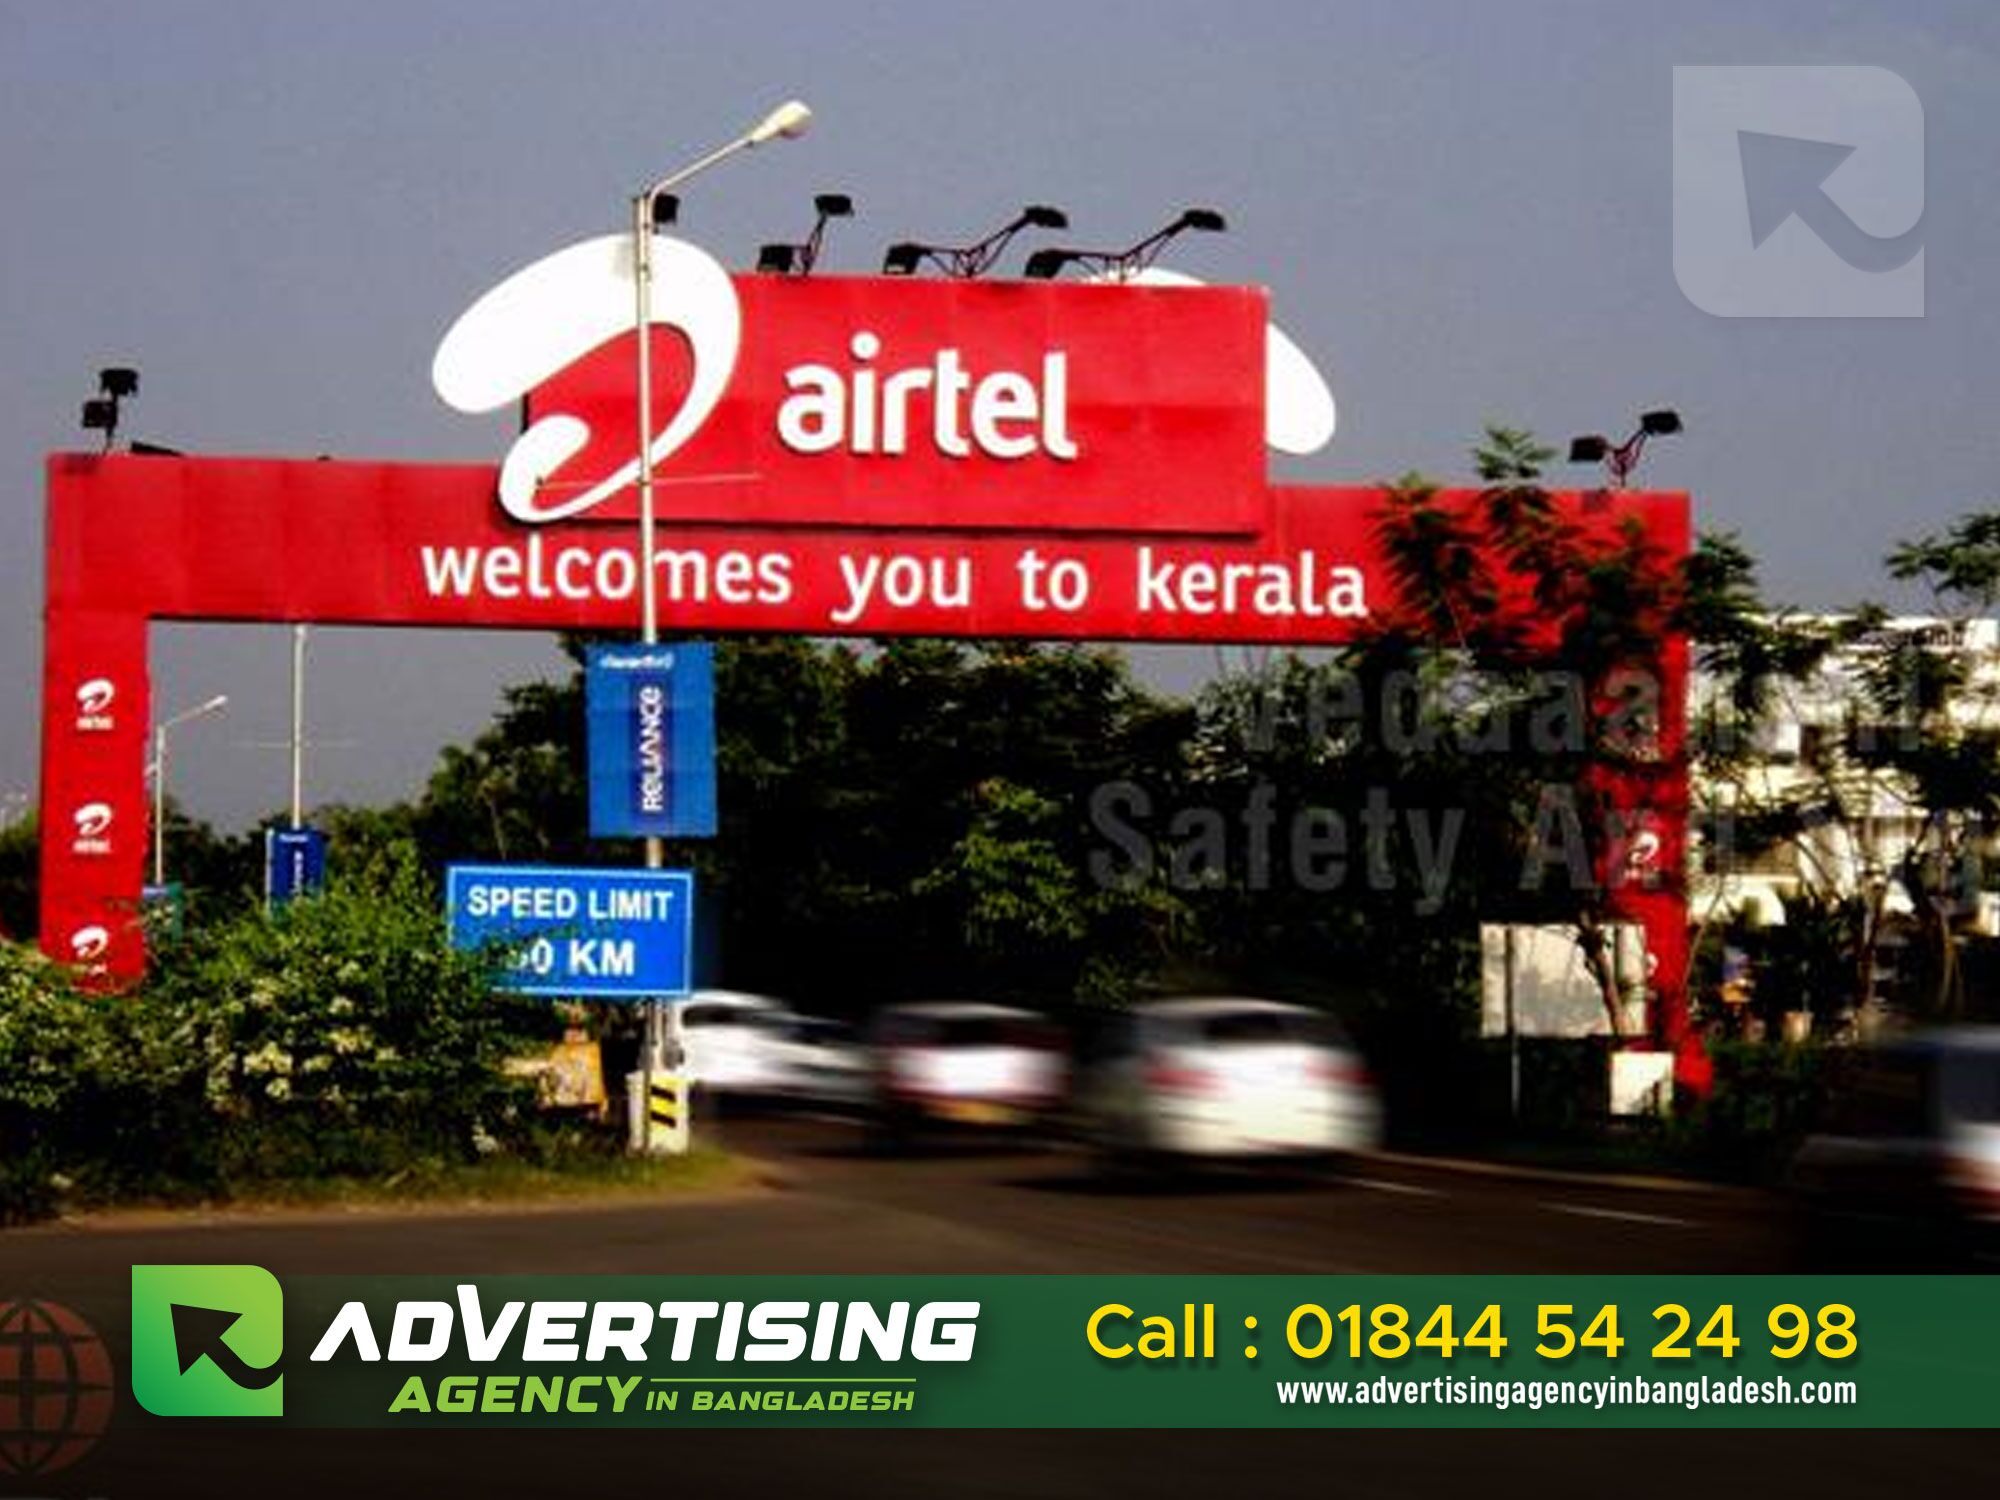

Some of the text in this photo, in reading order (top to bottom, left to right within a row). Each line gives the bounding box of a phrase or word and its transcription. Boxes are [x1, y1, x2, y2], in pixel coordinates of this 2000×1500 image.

[777, 331, 1078, 459] airtel
[421, 532, 1369, 623] welcomes you to kerala
[467, 885, 674, 921] SPEED LIMIT
[569, 939, 635, 977] KM
